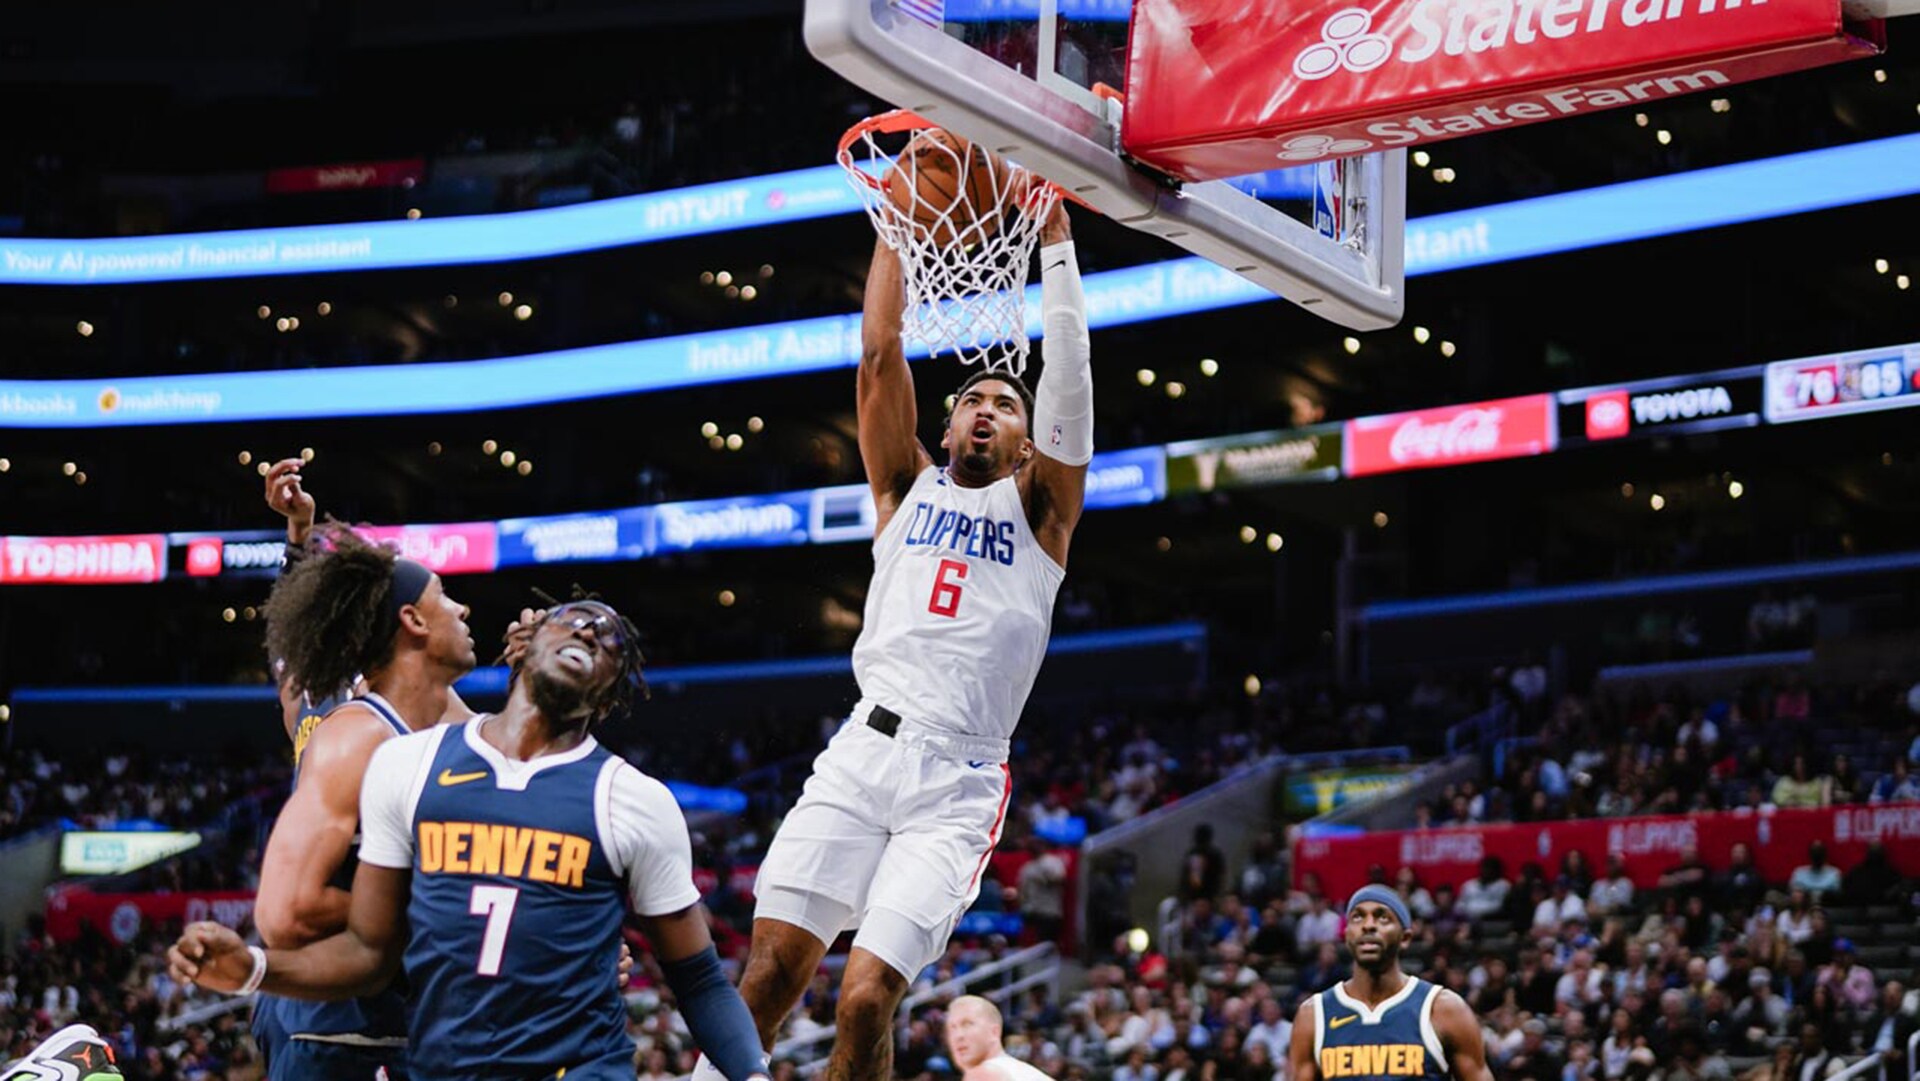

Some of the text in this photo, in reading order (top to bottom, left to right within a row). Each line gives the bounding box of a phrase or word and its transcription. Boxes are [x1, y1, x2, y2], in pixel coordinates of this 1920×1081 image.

[1367, 69, 1731, 147] StateFarm
[5, 249, 53, 272] Your
[188, 240, 276, 266] financial
[689, 330, 769, 372] Intuit
[1631, 386, 1732, 425] TOYOTA
[662, 503, 797, 548] Spectrum
[905, 502, 1015, 566] CLIPPERS
[6, 542, 156, 577] TOSHIBA
[928, 558, 969, 619] 6
[418, 821, 593, 889] DENVER
[468, 884, 520, 977] 7
[1321, 1043, 1425, 1080] DENVER
